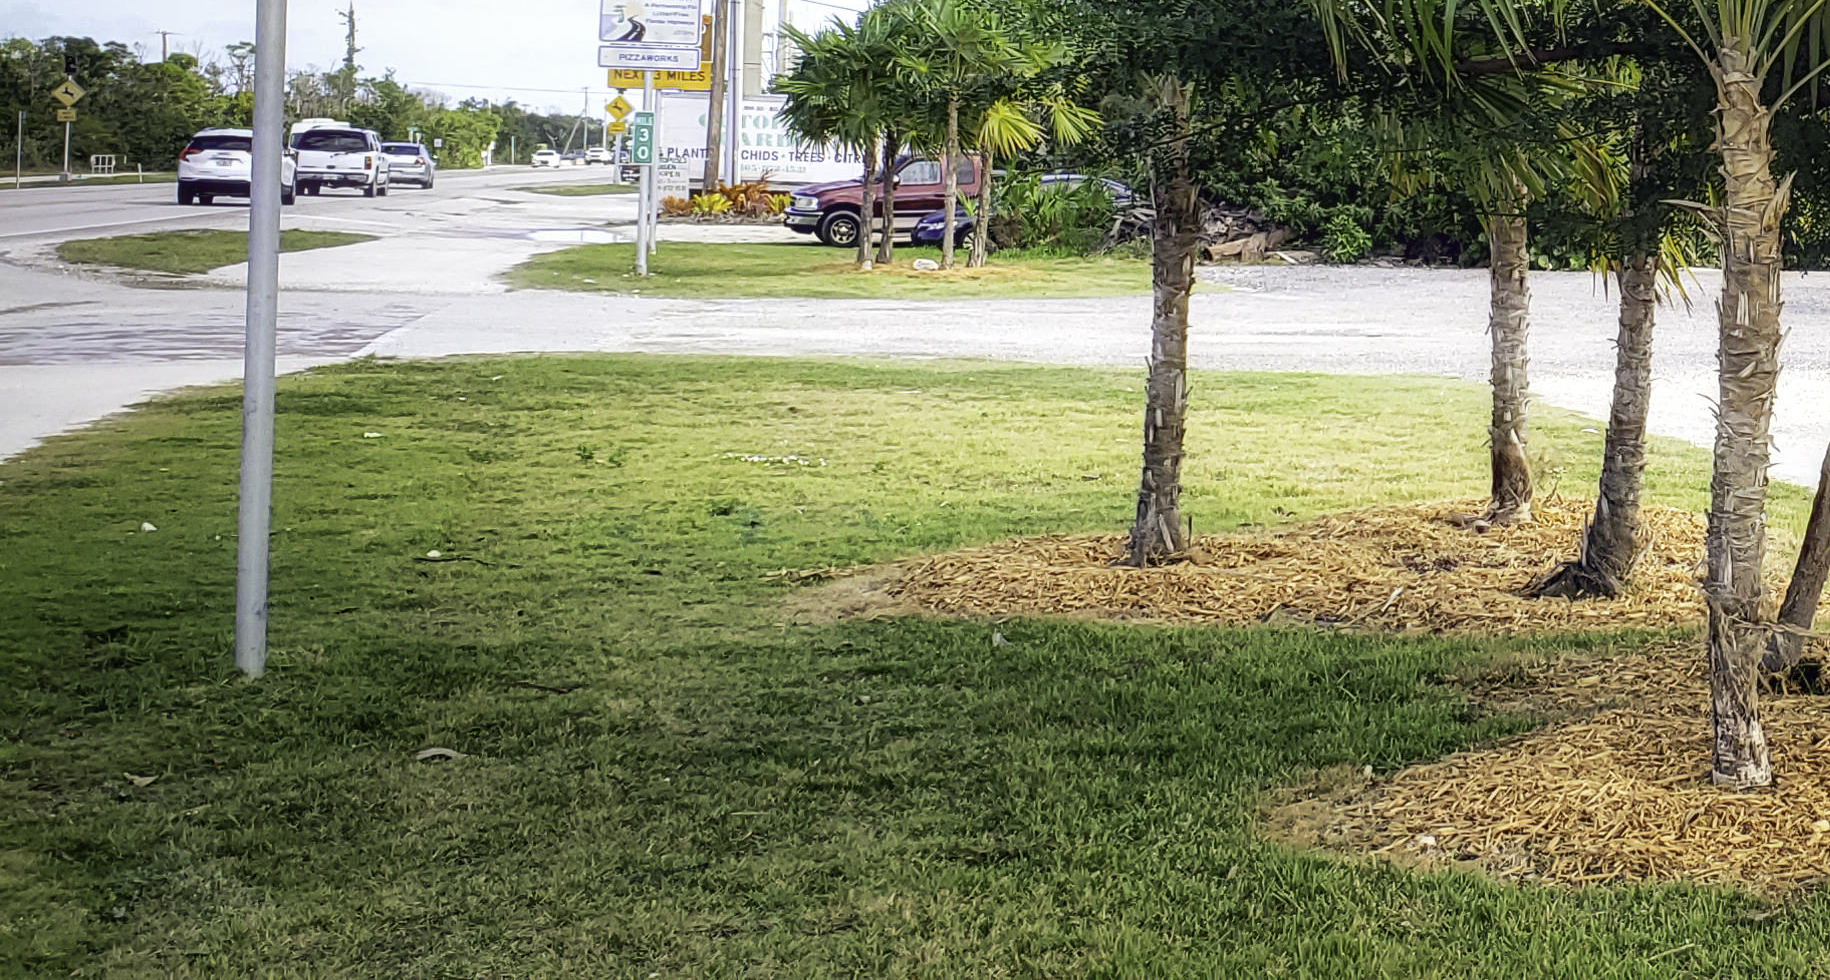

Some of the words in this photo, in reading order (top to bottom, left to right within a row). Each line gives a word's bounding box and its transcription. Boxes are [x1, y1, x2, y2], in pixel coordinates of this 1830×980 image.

[618, 53, 679, 63] PIZZAWORKS
[666, 71, 706, 82] MILES
[638, 128, 649, 160] 30
[667, 147, 708, 159] PLANT
[741, 150, 779, 162] CHIDS
[788, 152, 826, 163] TREES
